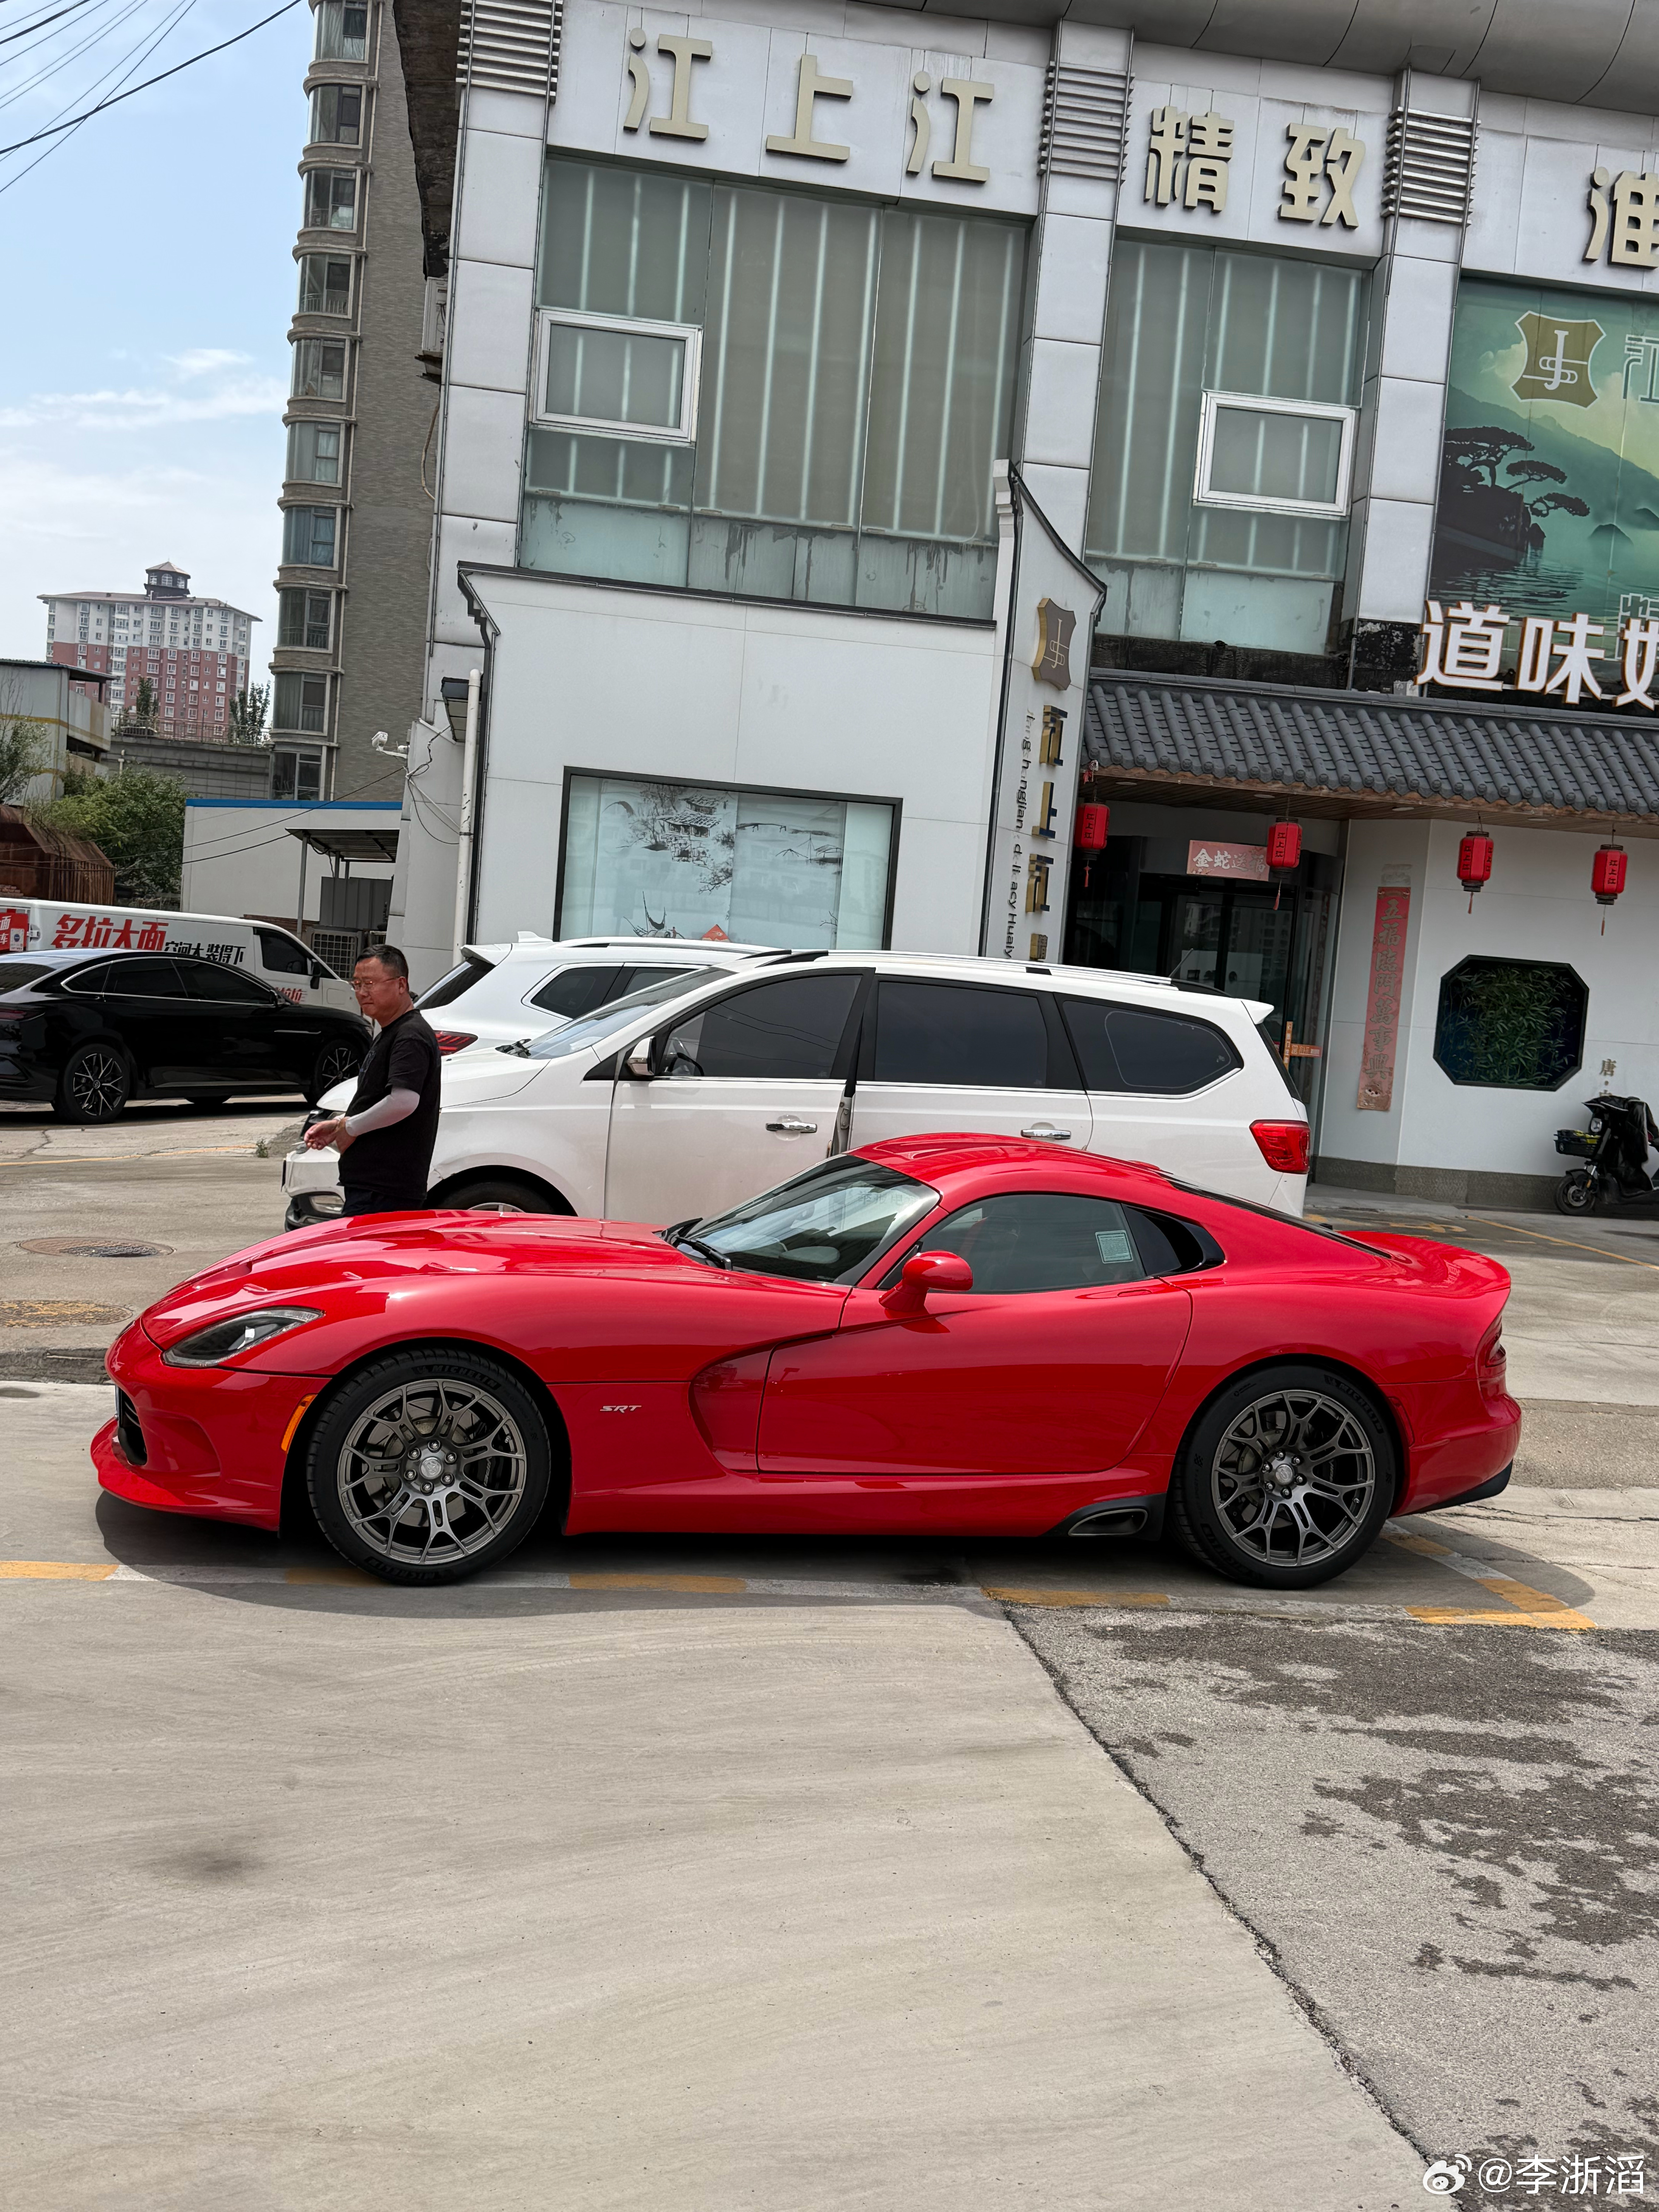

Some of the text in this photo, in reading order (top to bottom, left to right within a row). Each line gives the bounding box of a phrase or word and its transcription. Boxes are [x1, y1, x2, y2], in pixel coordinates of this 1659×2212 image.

[623, 27, 994, 184] 江上江
[1144, 106, 1366, 230] 精致
[1192, 848, 1266, 872] 金蛇送福
[431, 1365, 498, 1388] MICHELIN
[600, 1405, 642, 1413] SRT
